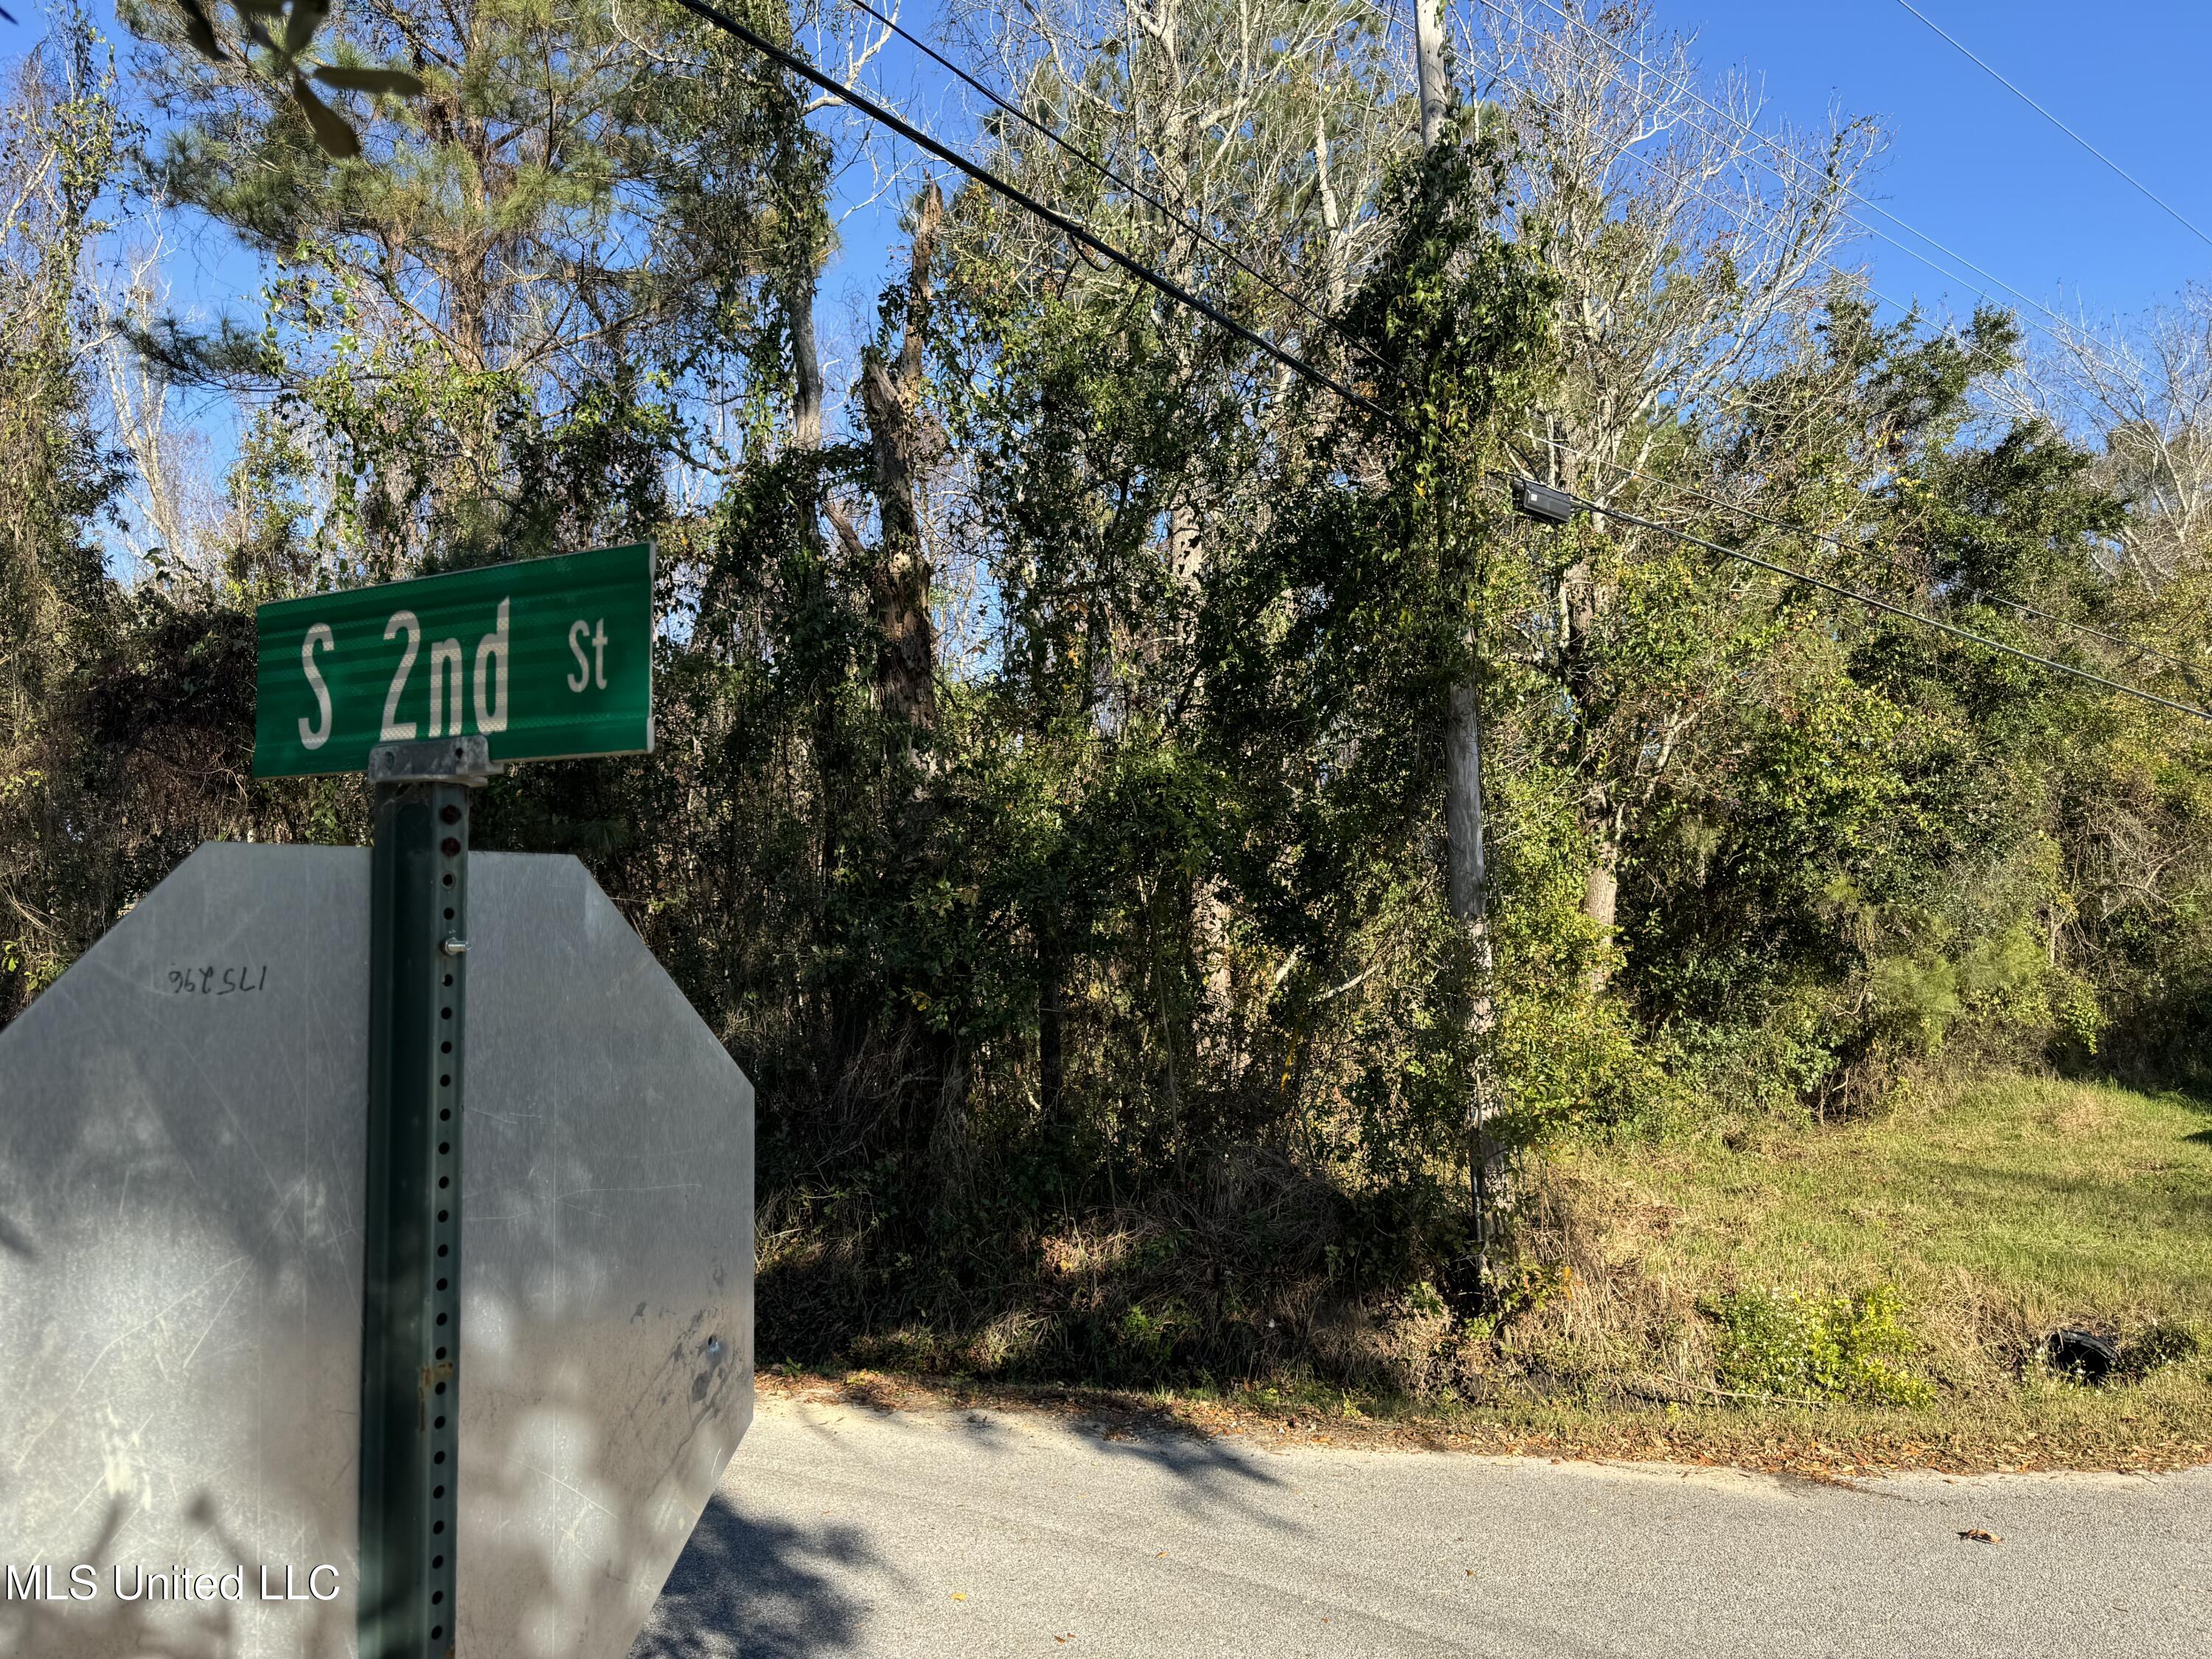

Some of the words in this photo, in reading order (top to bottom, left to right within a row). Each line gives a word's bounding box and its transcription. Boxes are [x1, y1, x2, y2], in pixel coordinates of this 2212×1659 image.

[298, 622, 335, 750] S
[379, 595, 510, 742] 2nd
[566, 617, 609, 693] St
